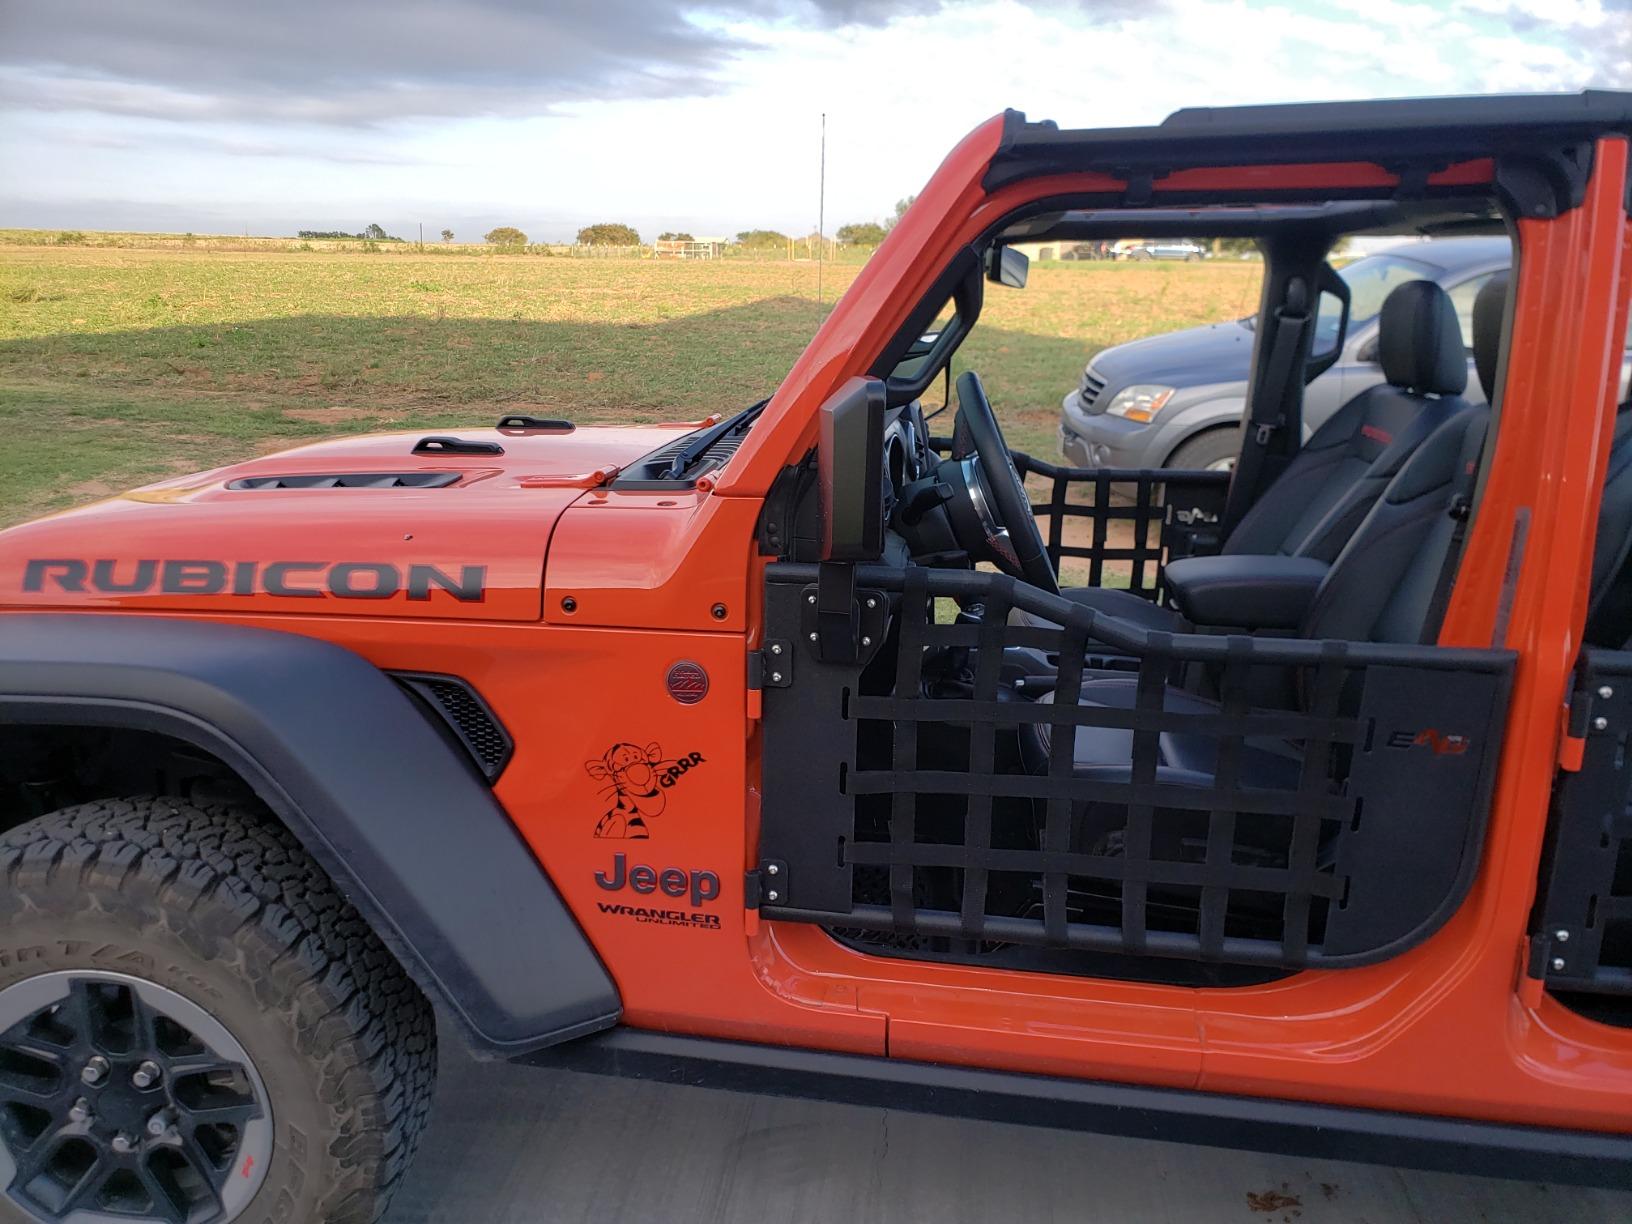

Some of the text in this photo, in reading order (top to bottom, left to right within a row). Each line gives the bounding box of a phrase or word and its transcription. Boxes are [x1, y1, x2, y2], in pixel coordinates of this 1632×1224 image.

[21, 558, 488, 603] RUBICON
[660, 751, 706, 789] GRRR
[594, 852, 721, 908] Jeep
[597, 902, 721, 925] WRANGLER
[636, 917, 722, 931] UNLIMITED
